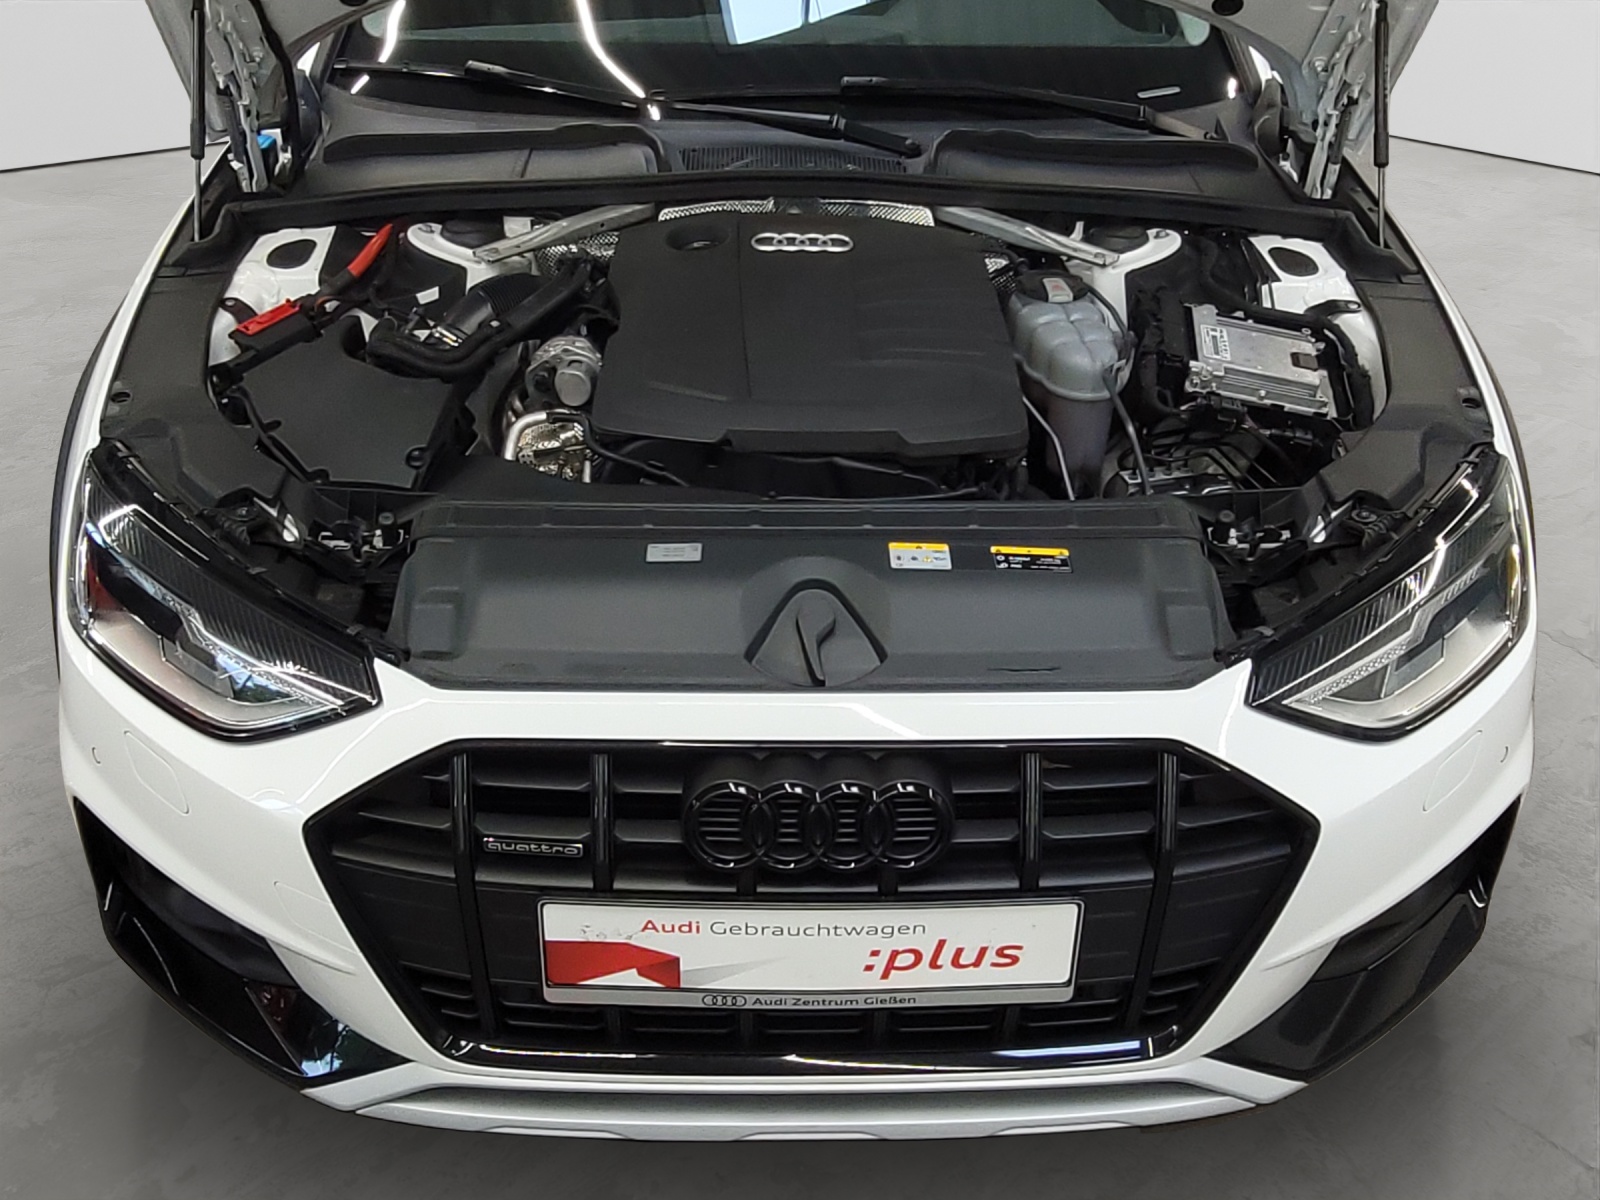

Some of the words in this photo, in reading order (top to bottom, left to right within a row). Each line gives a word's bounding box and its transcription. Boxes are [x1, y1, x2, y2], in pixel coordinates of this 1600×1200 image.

[487, 842, 579, 855] quattro
[641, 919, 701, 934] Audi
[709, 920, 927, 939] Gebrauchtwagen
[751, 997, 788, 1006] Audi
[791, 997, 860, 1006] Zentrum
[863, 996, 917, 1005] Gießen
